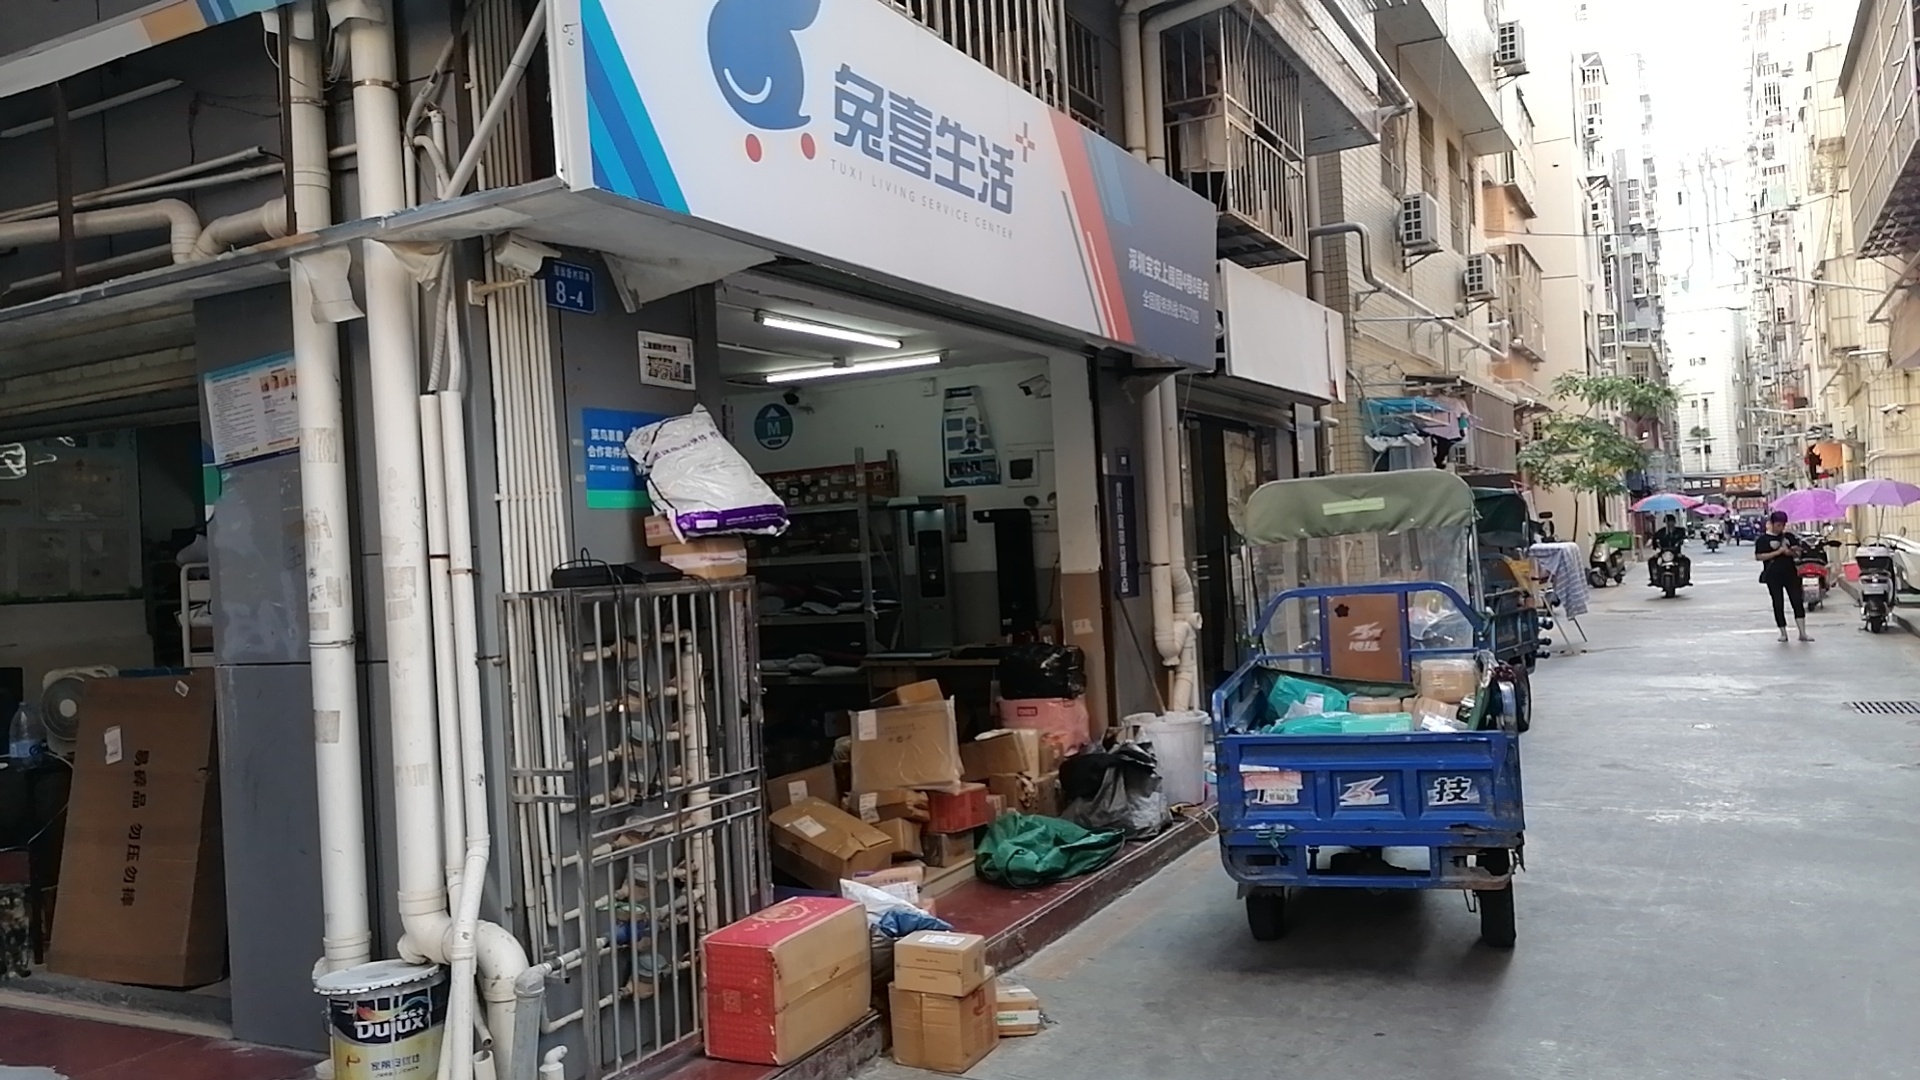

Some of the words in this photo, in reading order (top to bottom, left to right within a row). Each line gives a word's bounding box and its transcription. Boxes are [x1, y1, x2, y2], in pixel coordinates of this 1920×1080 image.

[834, 63, 1014, 215] 兔喜生活
[830, 158, 862, 183] TUXI
[872, 174, 916, 204] LIVING
[921, 195, 969, 224] SERVICE
[975, 216, 1014, 240] CENTER
[556, 280, 583, 307] 8-4
[1433, 776, 1472, 803] 技
[354, 1016, 424, 1043] Dulux
